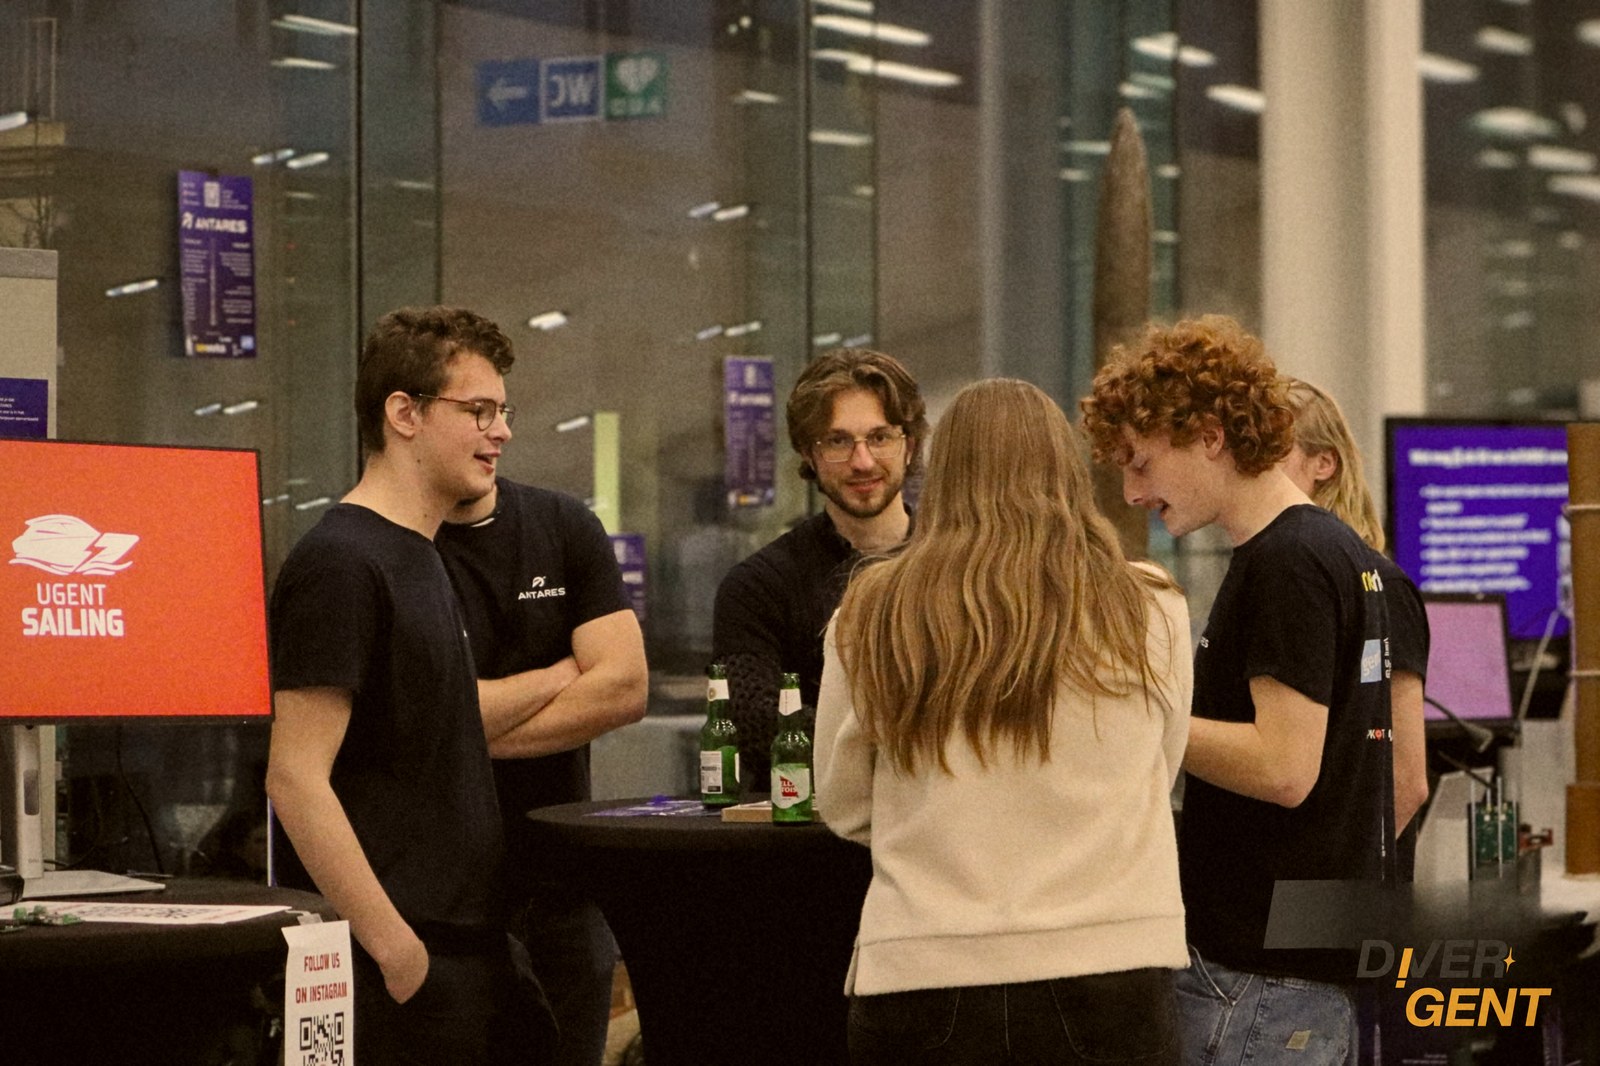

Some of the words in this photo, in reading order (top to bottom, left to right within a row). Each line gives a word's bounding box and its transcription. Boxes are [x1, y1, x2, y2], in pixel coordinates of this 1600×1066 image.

[195, 217, 248, 234] ANTARES
[36, 582, 107, 606] UGENT
[518, 587, 566, 600] ANTARES
[21, 607, 125, 637] SAILING
[304, 953, 330, 972] FOLLOW
[331, 952, 340, 969] US
[295, 986, 307, 1004] ON
[309, 981, 347, 1002] INSTAGRAM
